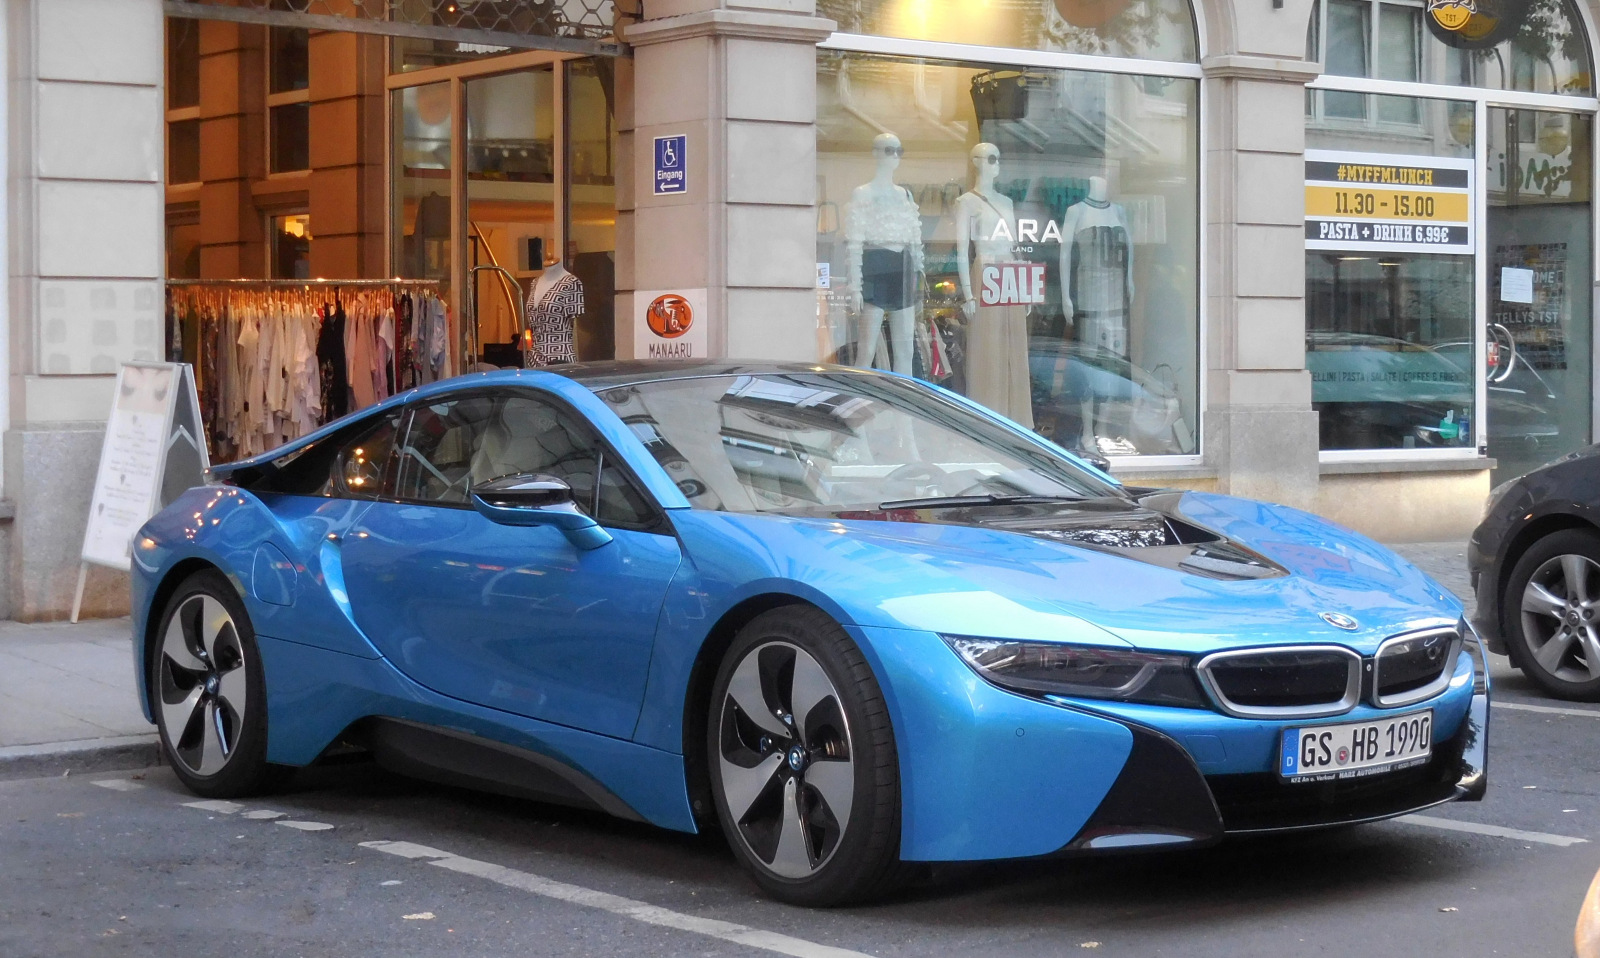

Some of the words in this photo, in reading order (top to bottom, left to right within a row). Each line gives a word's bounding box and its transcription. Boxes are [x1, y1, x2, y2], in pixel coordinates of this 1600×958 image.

[1445, 14, 1457, 22] TST
[657, 170, 683, 182] Eingang
[1337, 165, 1433, 185] #MYFFMLUNCH
[1335, 192, 1375, 214] 11.30
[1394, 195, 1434, 217] 15.00
[1319, 222, 1359, 240] PASTA
[1373, 224, 1413, 241] DRINK
[1415, 226, 1449, 244] 6,99€
[981, 266, 1044, 305] SALE
[1495, 311, 1535, 324] TELLYS
[1538, 311, 1559, 323] TST
[649, 342, 692, 358] MANAARU
[1309, 371, 1336, 382] ELLINI
[1342, 371, 1365, 382] PASTA
[1371, 371, 1397, 382] SALATE
[1301, 732, 1332, 767] GS
[1351, 726, 1379, 762] HB
[1385, 717, 1430, 757] 1990
[1287, 756, 1293, 767] D
